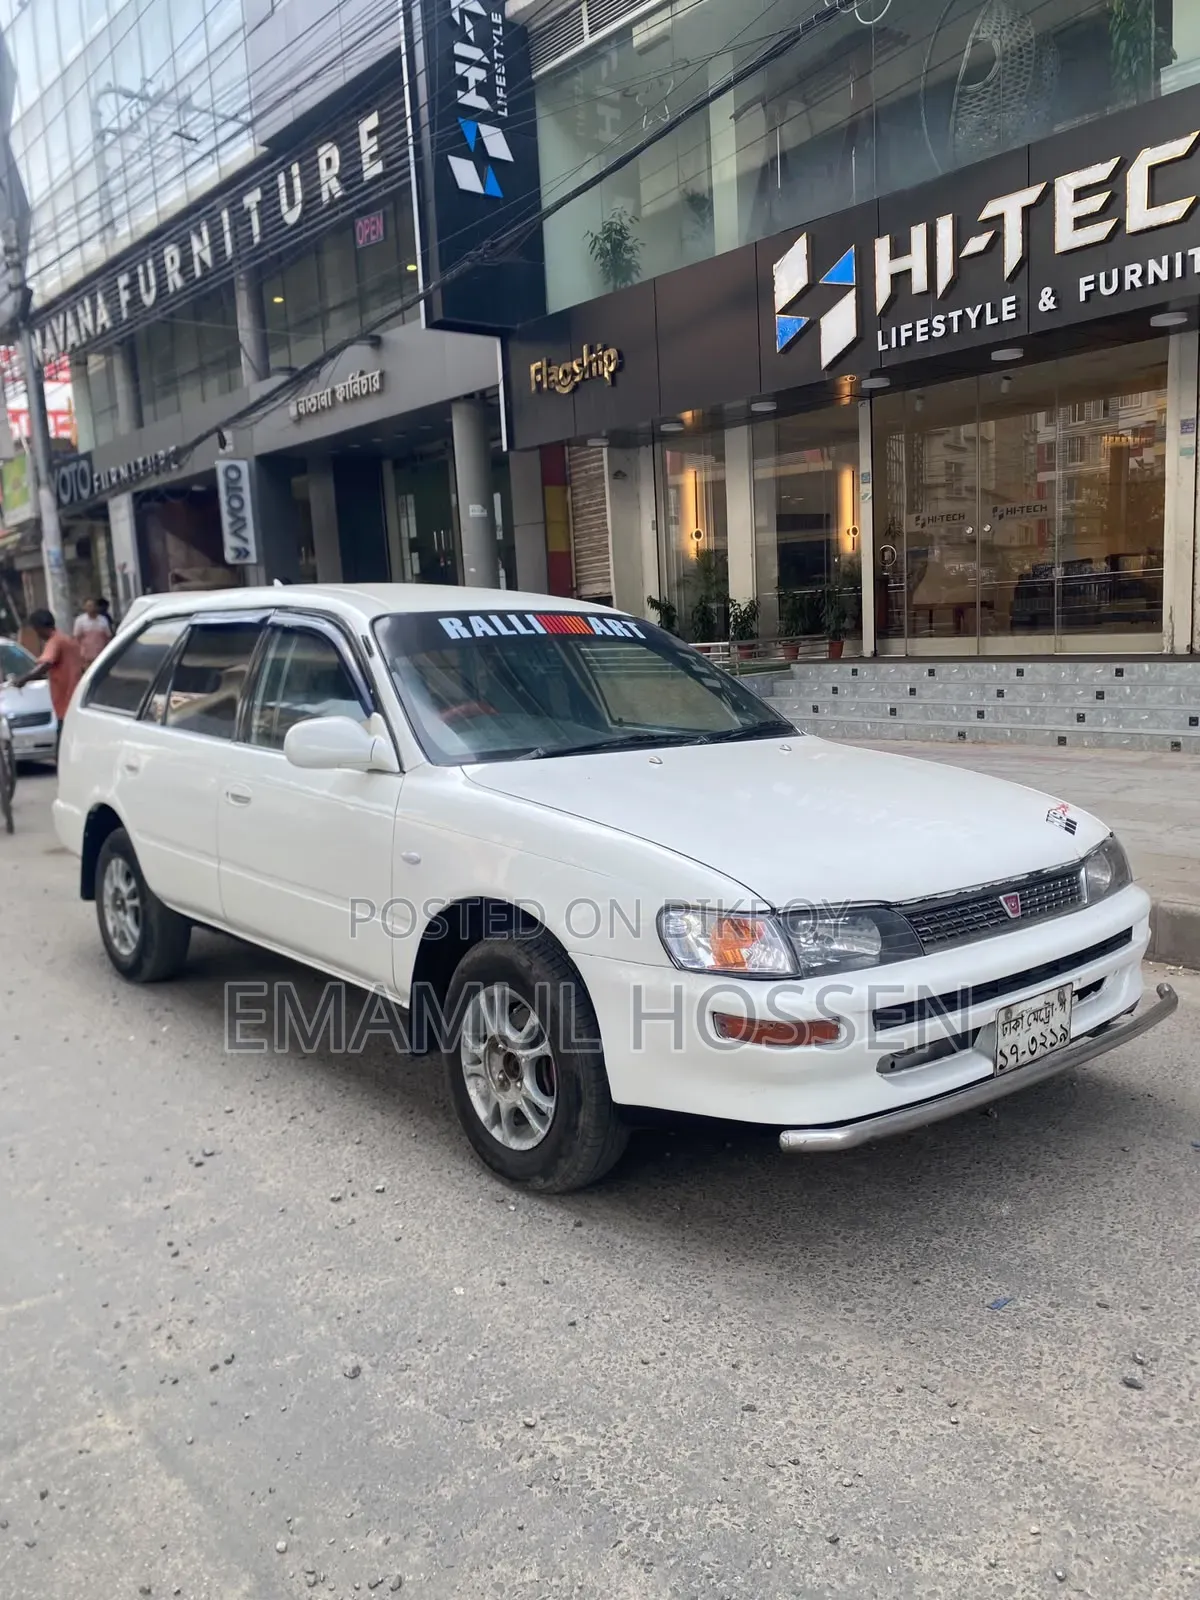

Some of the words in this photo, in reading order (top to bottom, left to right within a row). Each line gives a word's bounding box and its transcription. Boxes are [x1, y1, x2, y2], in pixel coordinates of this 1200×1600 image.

[491, 11, 509, 117] LIFESTYLE
[117, 110, 384, 320] FURNITURE
[356, 215, 383, 246] OPEN
[874, 130, 1200, 316] HI-TEC
[876, 295, 1017, 352] LIFESTYLE
[1038, 286, 1058, 312] &
[529, 343, 619, 394] Flagship
[927, 512, 966, 524] HI-TECH
[1005, 504, 1048, 515] HI-TECH
[438, 614, 548, 639] RALLI
[586, 616, 647, 639] ART
[998, 1024, 1069, 1070] ১৭-৩২১৯
[1001, 1013, 1025, 1037] ঢাকা
